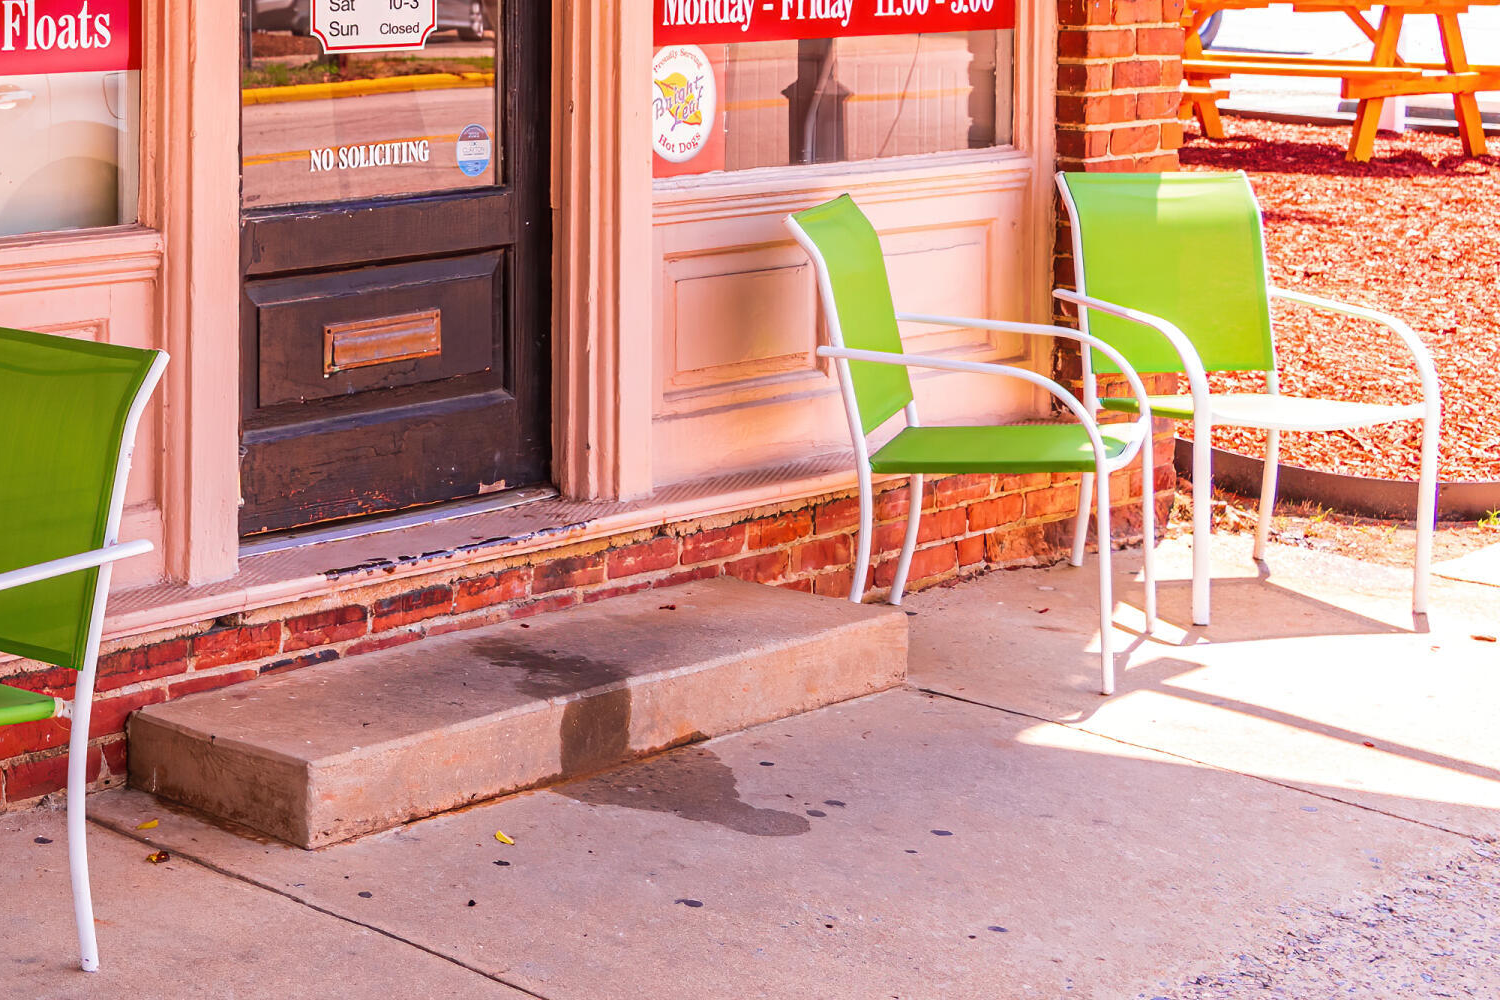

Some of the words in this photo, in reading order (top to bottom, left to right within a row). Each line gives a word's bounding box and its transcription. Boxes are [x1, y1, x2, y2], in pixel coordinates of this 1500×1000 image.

[329, 21, 359, 37] Sun
[380, 22, 420, 35] Closed
[652, 75, 705, 120] Bright
[309, 148, 335, 172] NO
[338, 139, 430, 170] SOLICITING
[658, 134, 676, 153] Hot
[679, 132, 702, 154] Dogs
